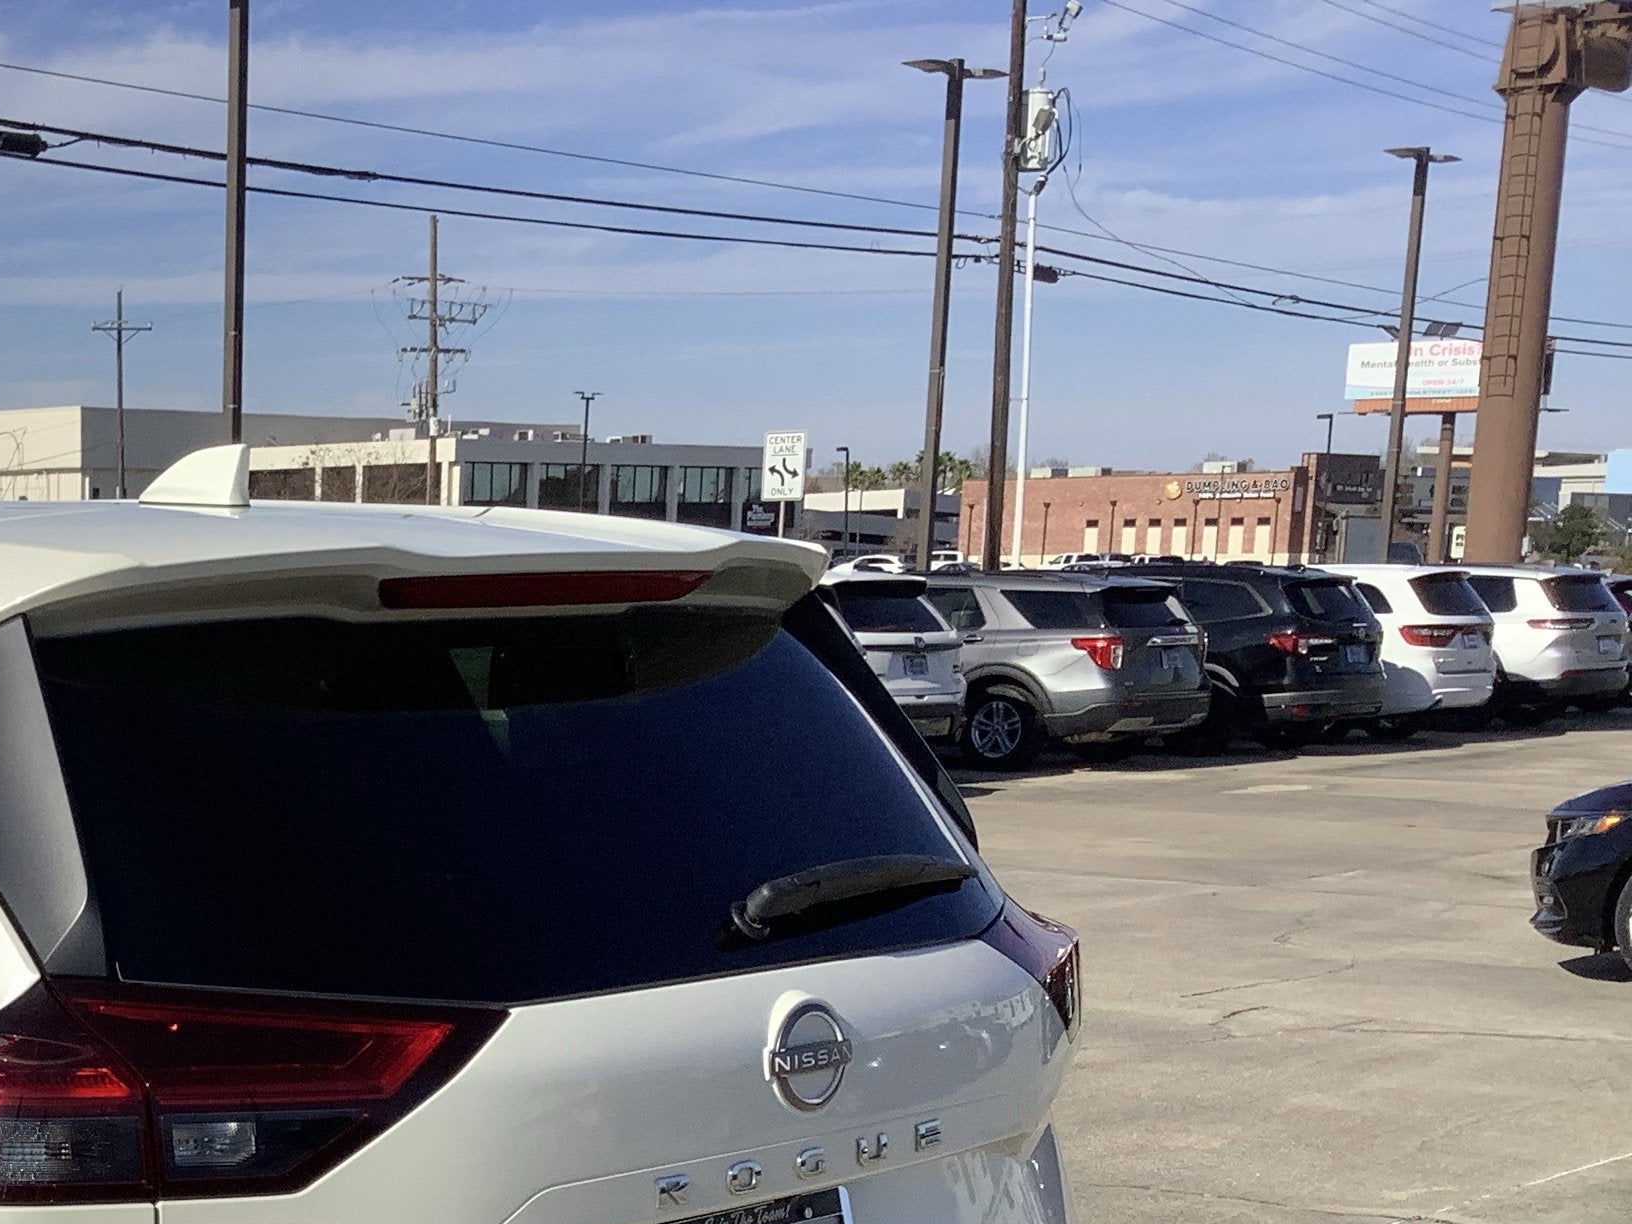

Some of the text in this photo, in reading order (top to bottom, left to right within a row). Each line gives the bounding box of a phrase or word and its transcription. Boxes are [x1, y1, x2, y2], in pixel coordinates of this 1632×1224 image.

[769, 436, 802, 444] CENTER
[773, 445, 795, 453] LANE
[1263, 479, 1289, 490] BAO
[771, 488, 793, 496] ONLY
[773, 1040, 852, 1073] NISSAN
[655, 1118, 943, 1210] ROGUE
